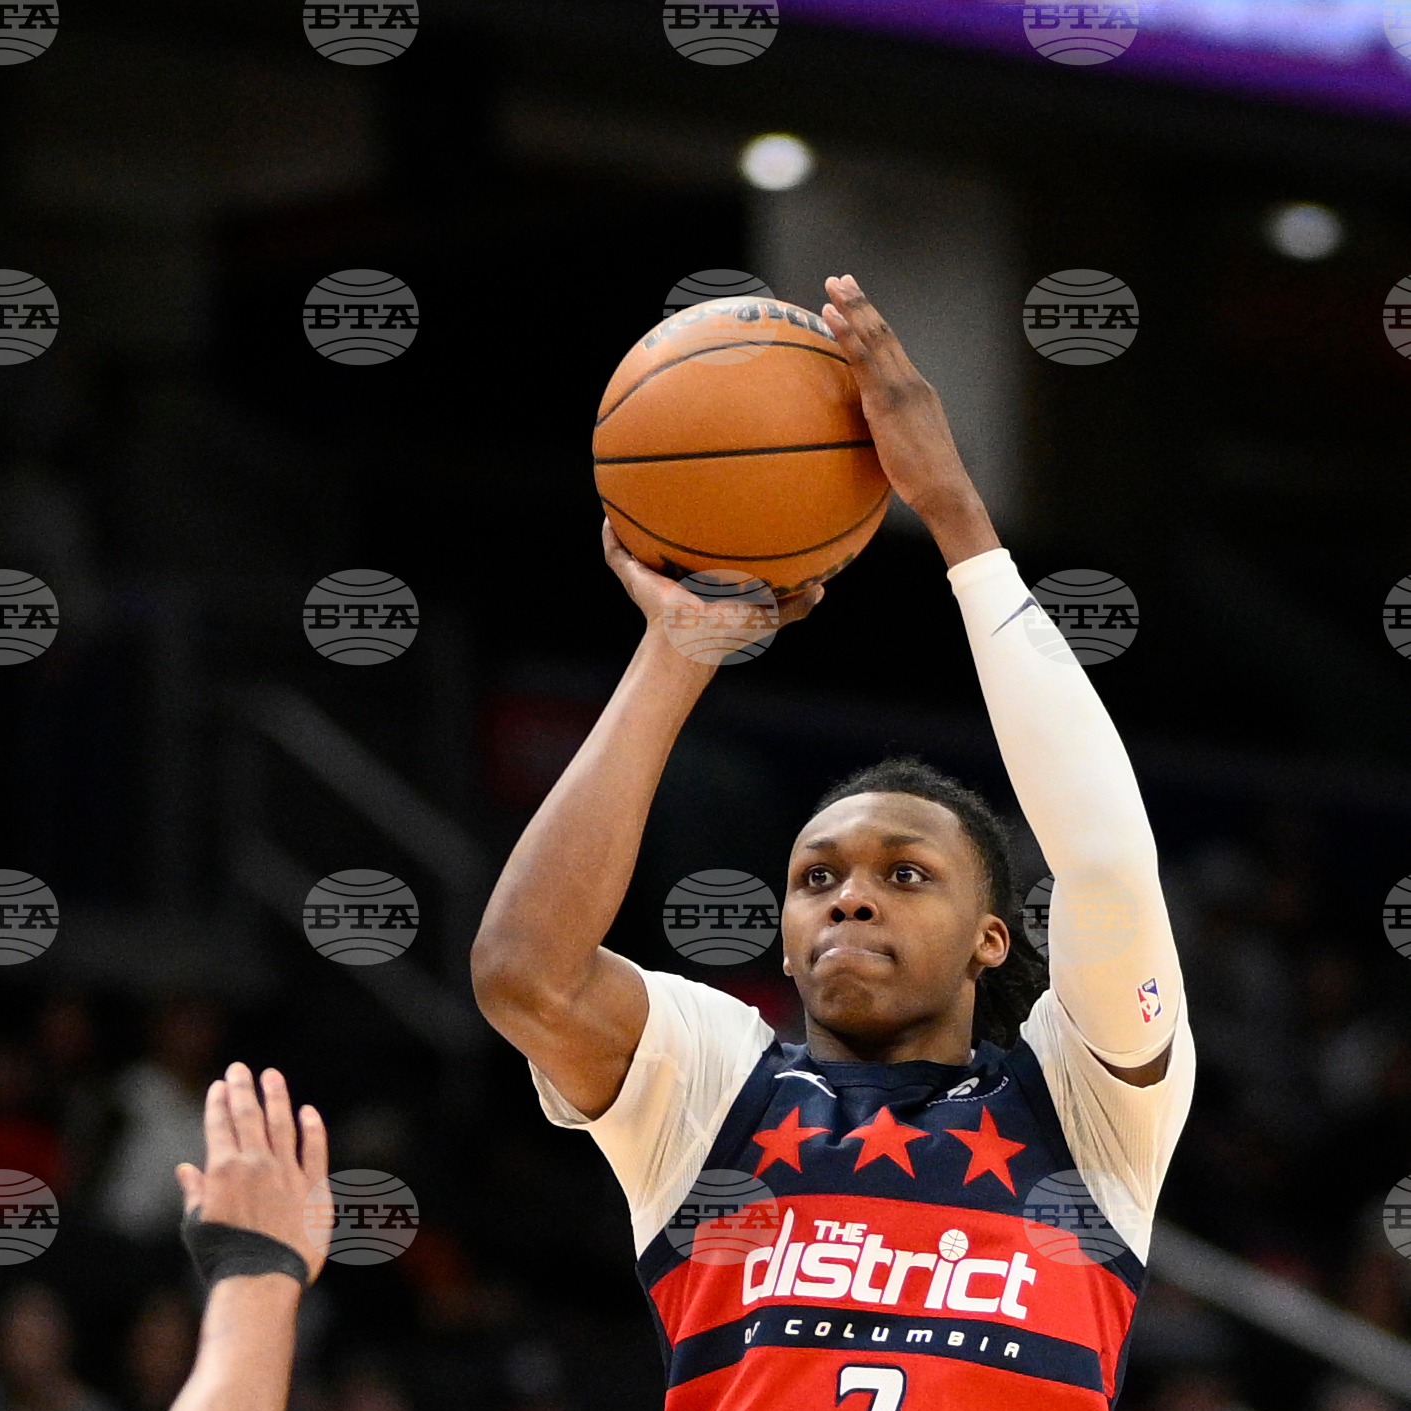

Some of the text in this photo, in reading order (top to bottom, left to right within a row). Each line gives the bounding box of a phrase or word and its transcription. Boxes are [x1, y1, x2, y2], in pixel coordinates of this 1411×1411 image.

[813, 1219, 868, 1244] THE
[742, 1206, 1037, 1320] district
[784, 1318, 1020, 1359] COLUMBIA
